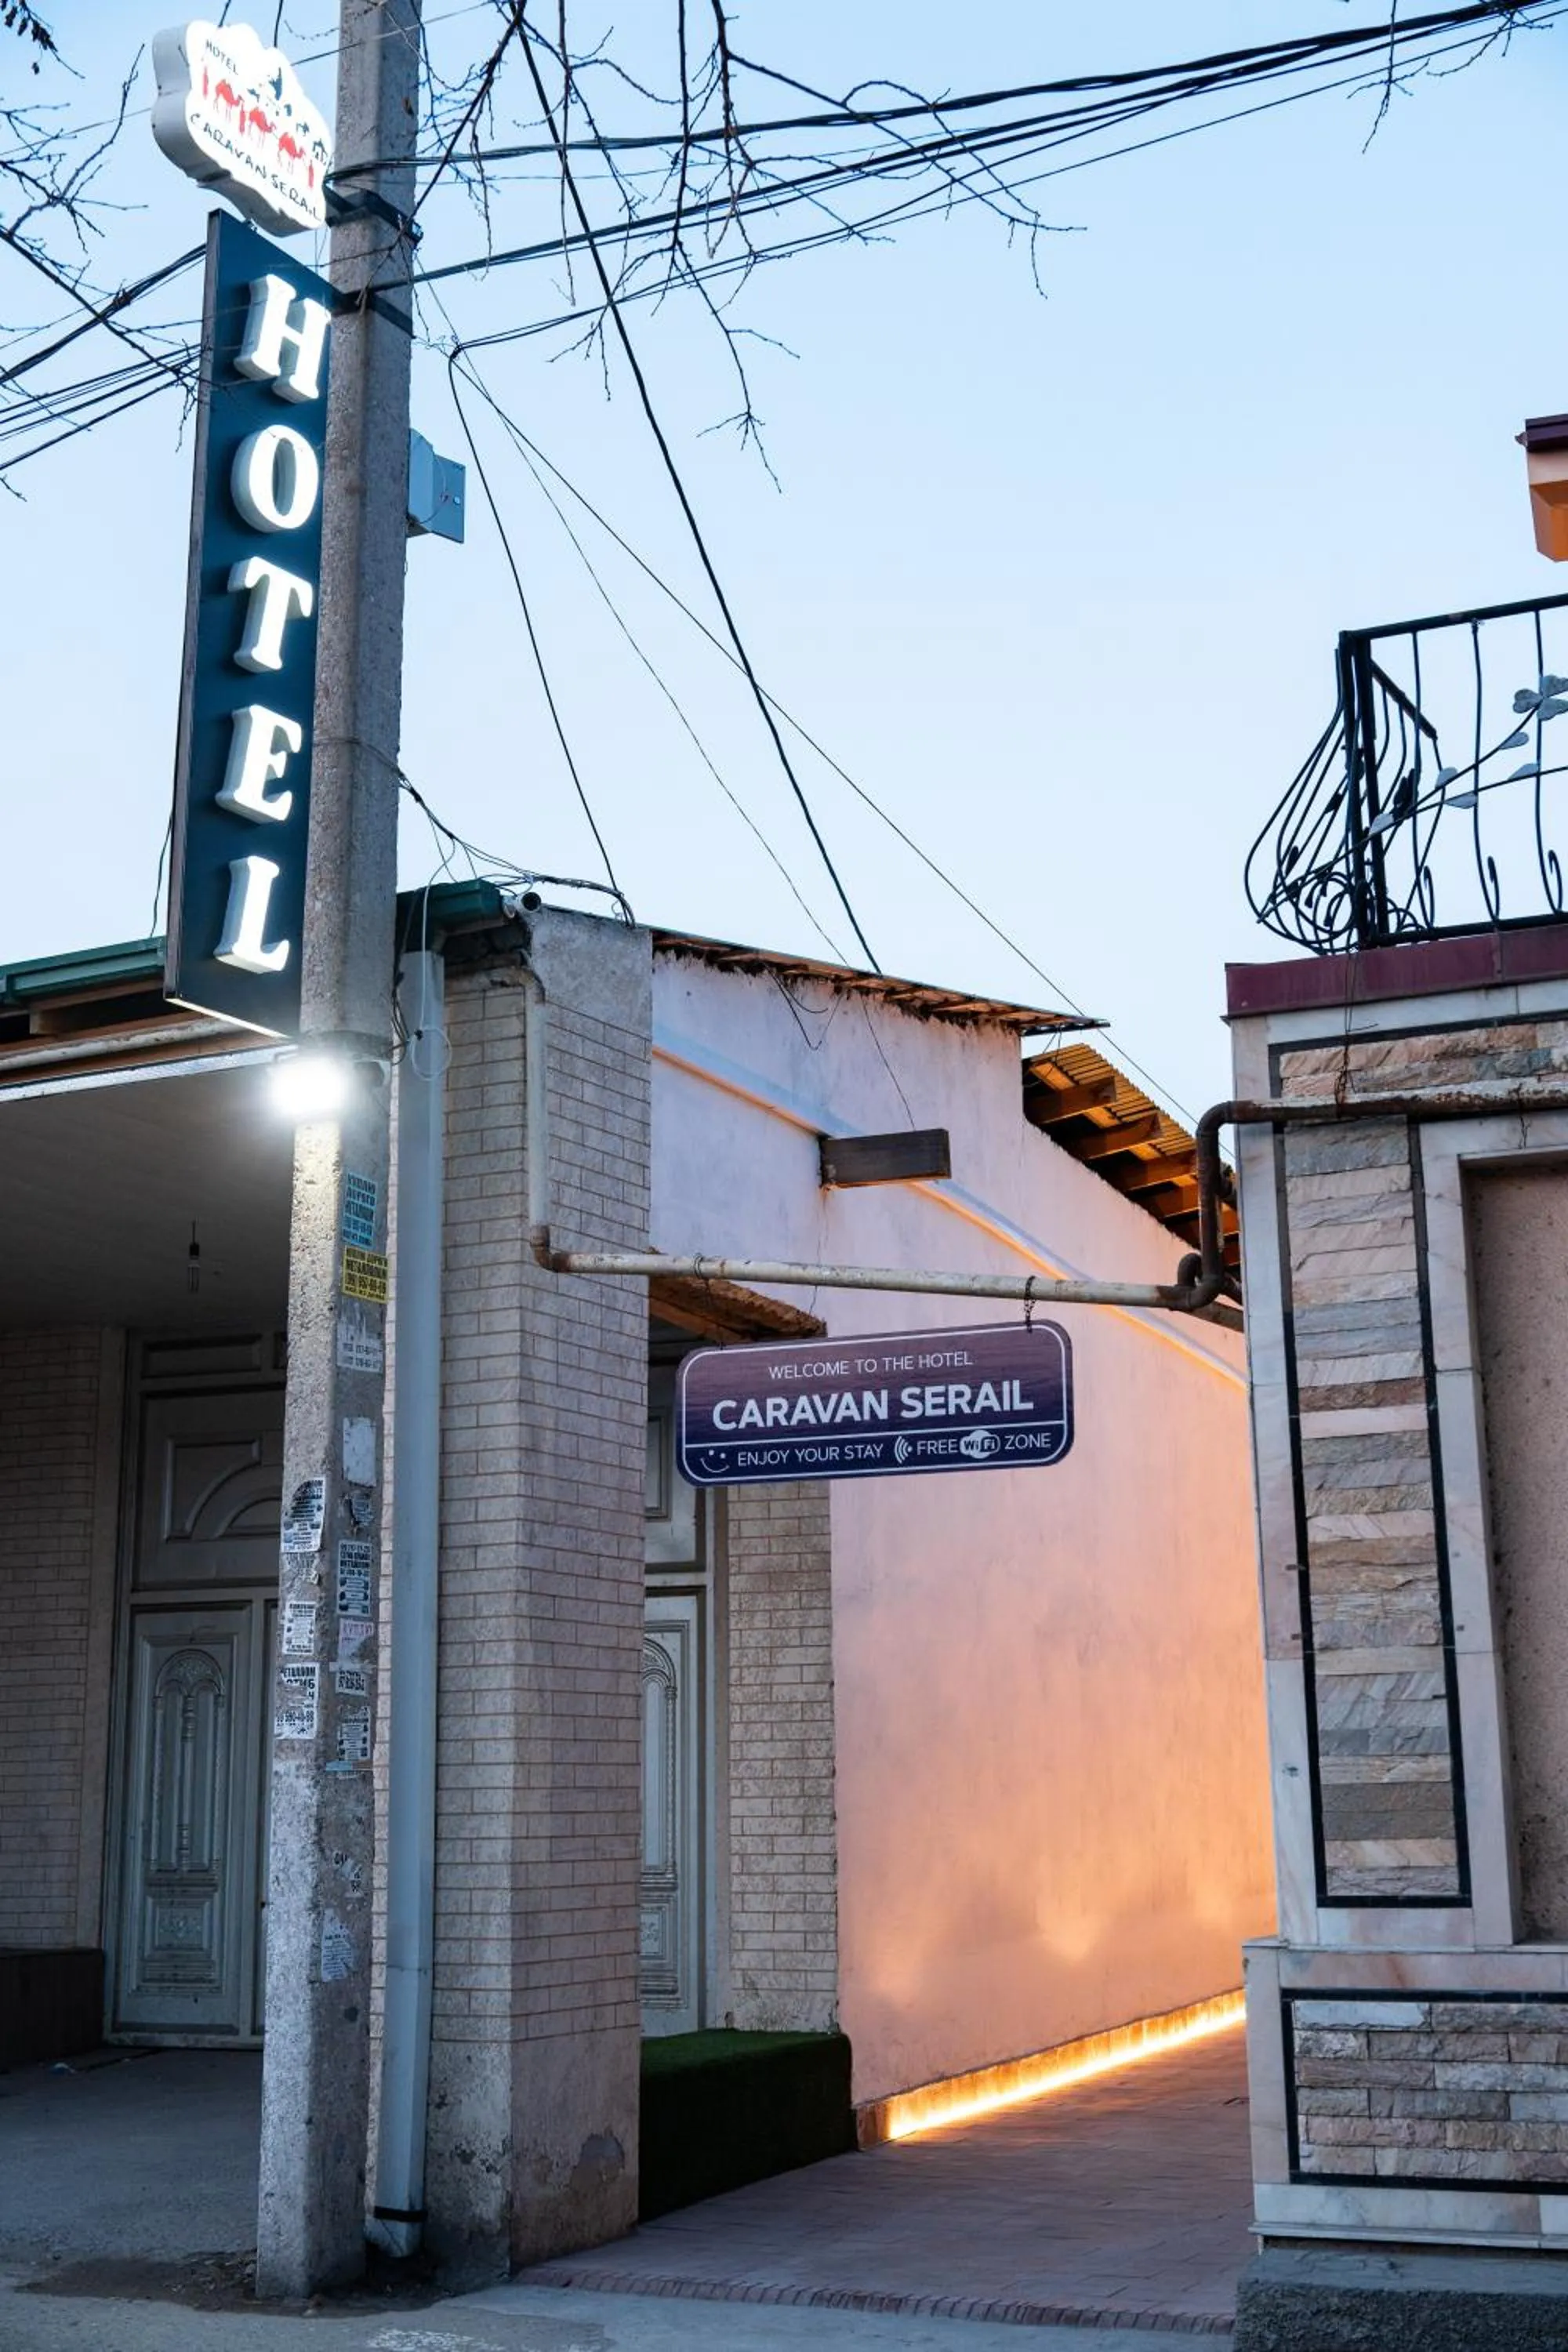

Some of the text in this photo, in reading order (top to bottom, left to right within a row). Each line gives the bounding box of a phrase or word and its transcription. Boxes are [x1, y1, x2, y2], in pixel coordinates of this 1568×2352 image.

[205, 38, 238, 75] HOTEL
[213, 272, 331, 975] HOTEL
[769, 1351, 973, 1380] WELCOME TO THE HOTEL
[713, 1379, 1034, 1431] CARAVAN SERAIL
[738, 1448, 789, 1466] ENJOY
[794, 1445, 841, 1462] YOUR
[844, 1443, 884, 1460] STAY
[916, 1439, 957, 1456] FREE
[1004, 1432, 1051, 1450] ZONE
